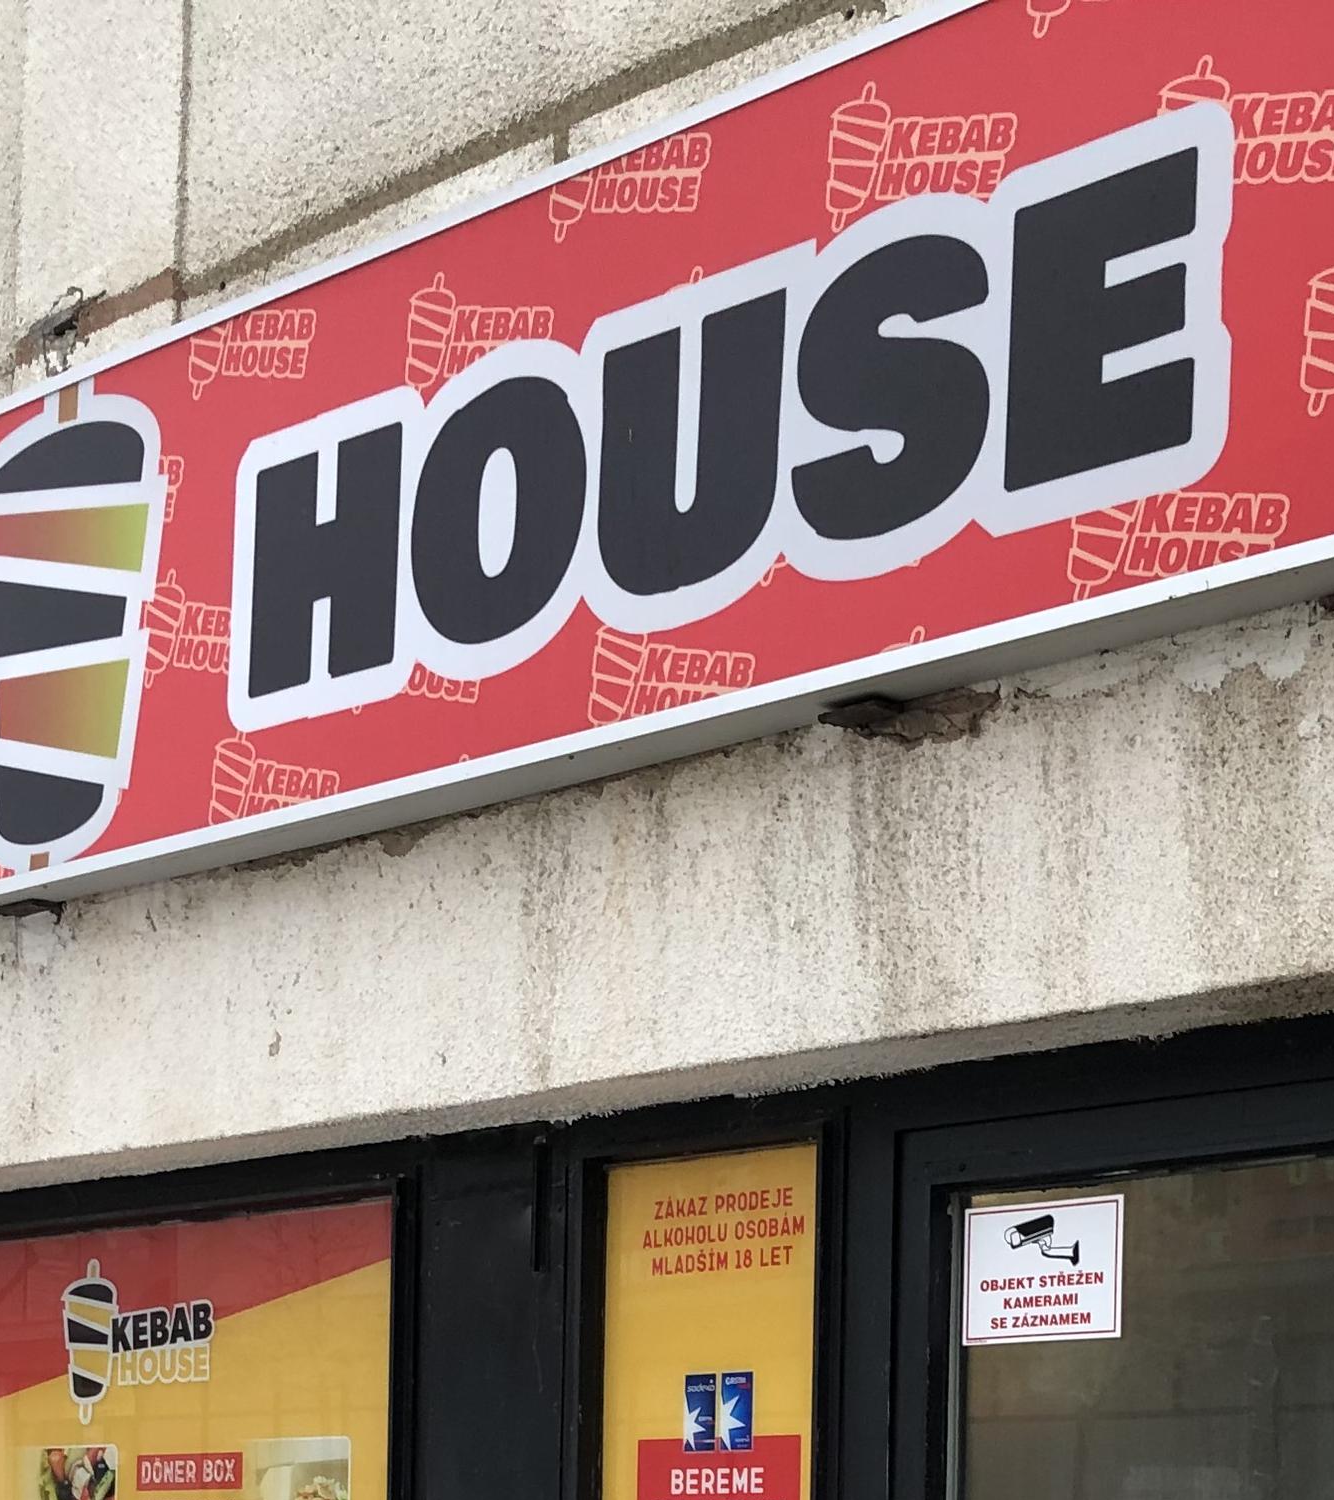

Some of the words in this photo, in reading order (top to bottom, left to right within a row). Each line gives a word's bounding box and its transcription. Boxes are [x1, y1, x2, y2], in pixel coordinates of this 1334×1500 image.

[886, 113, 1017, 161] KEBAB
[591, 172, 702, 213] HOUSE
[876, 157, 1005, 199] HOUSE
[228, 309, 317, 343] KEBAB
[452, 305, 555, 342] KEBAB
[221, 342, 310, 379] HOUSE
[246, 143, 1201, 702] HOUSE
[1139, 491, 1291, 538] KEBAB
[180, 601, 231, 639] KEB
[639, 643, 756, 690] KEBAB
[654, 1193, 708, 1221] ZÁKAZ
[714, 1187, 794, 1214] PRODEJE
[643, 1221, 728, 1249] ALKOHOLU
[734, 1214, 806, 1241] OSOBÁM
[652, 1248, 729, 1276] MLADŠÍM
[735, 1249, 753, 1269] 18
[760, 1245, 794, 1267] LET
[980, 1276, 1035, 1292] OBJEKT
[1039, 1271, 1104, 1288] STŘEŽEN
[1003, 1293, 1078, 1310] KAMERAMI
[110, 1302, 214, 1355] KEBAB
[990, 1317, 1008, 1329] SE
[1012, 1312, 1091, 1328] ZÁZNAMEM
[116, 1346, 211, 1385] HOUSE
[140, 1457, 197, 1485] DÖNER
[202, 1458, 236, 1484] BOX
[670, 1467, 765, 1496] BEREME
